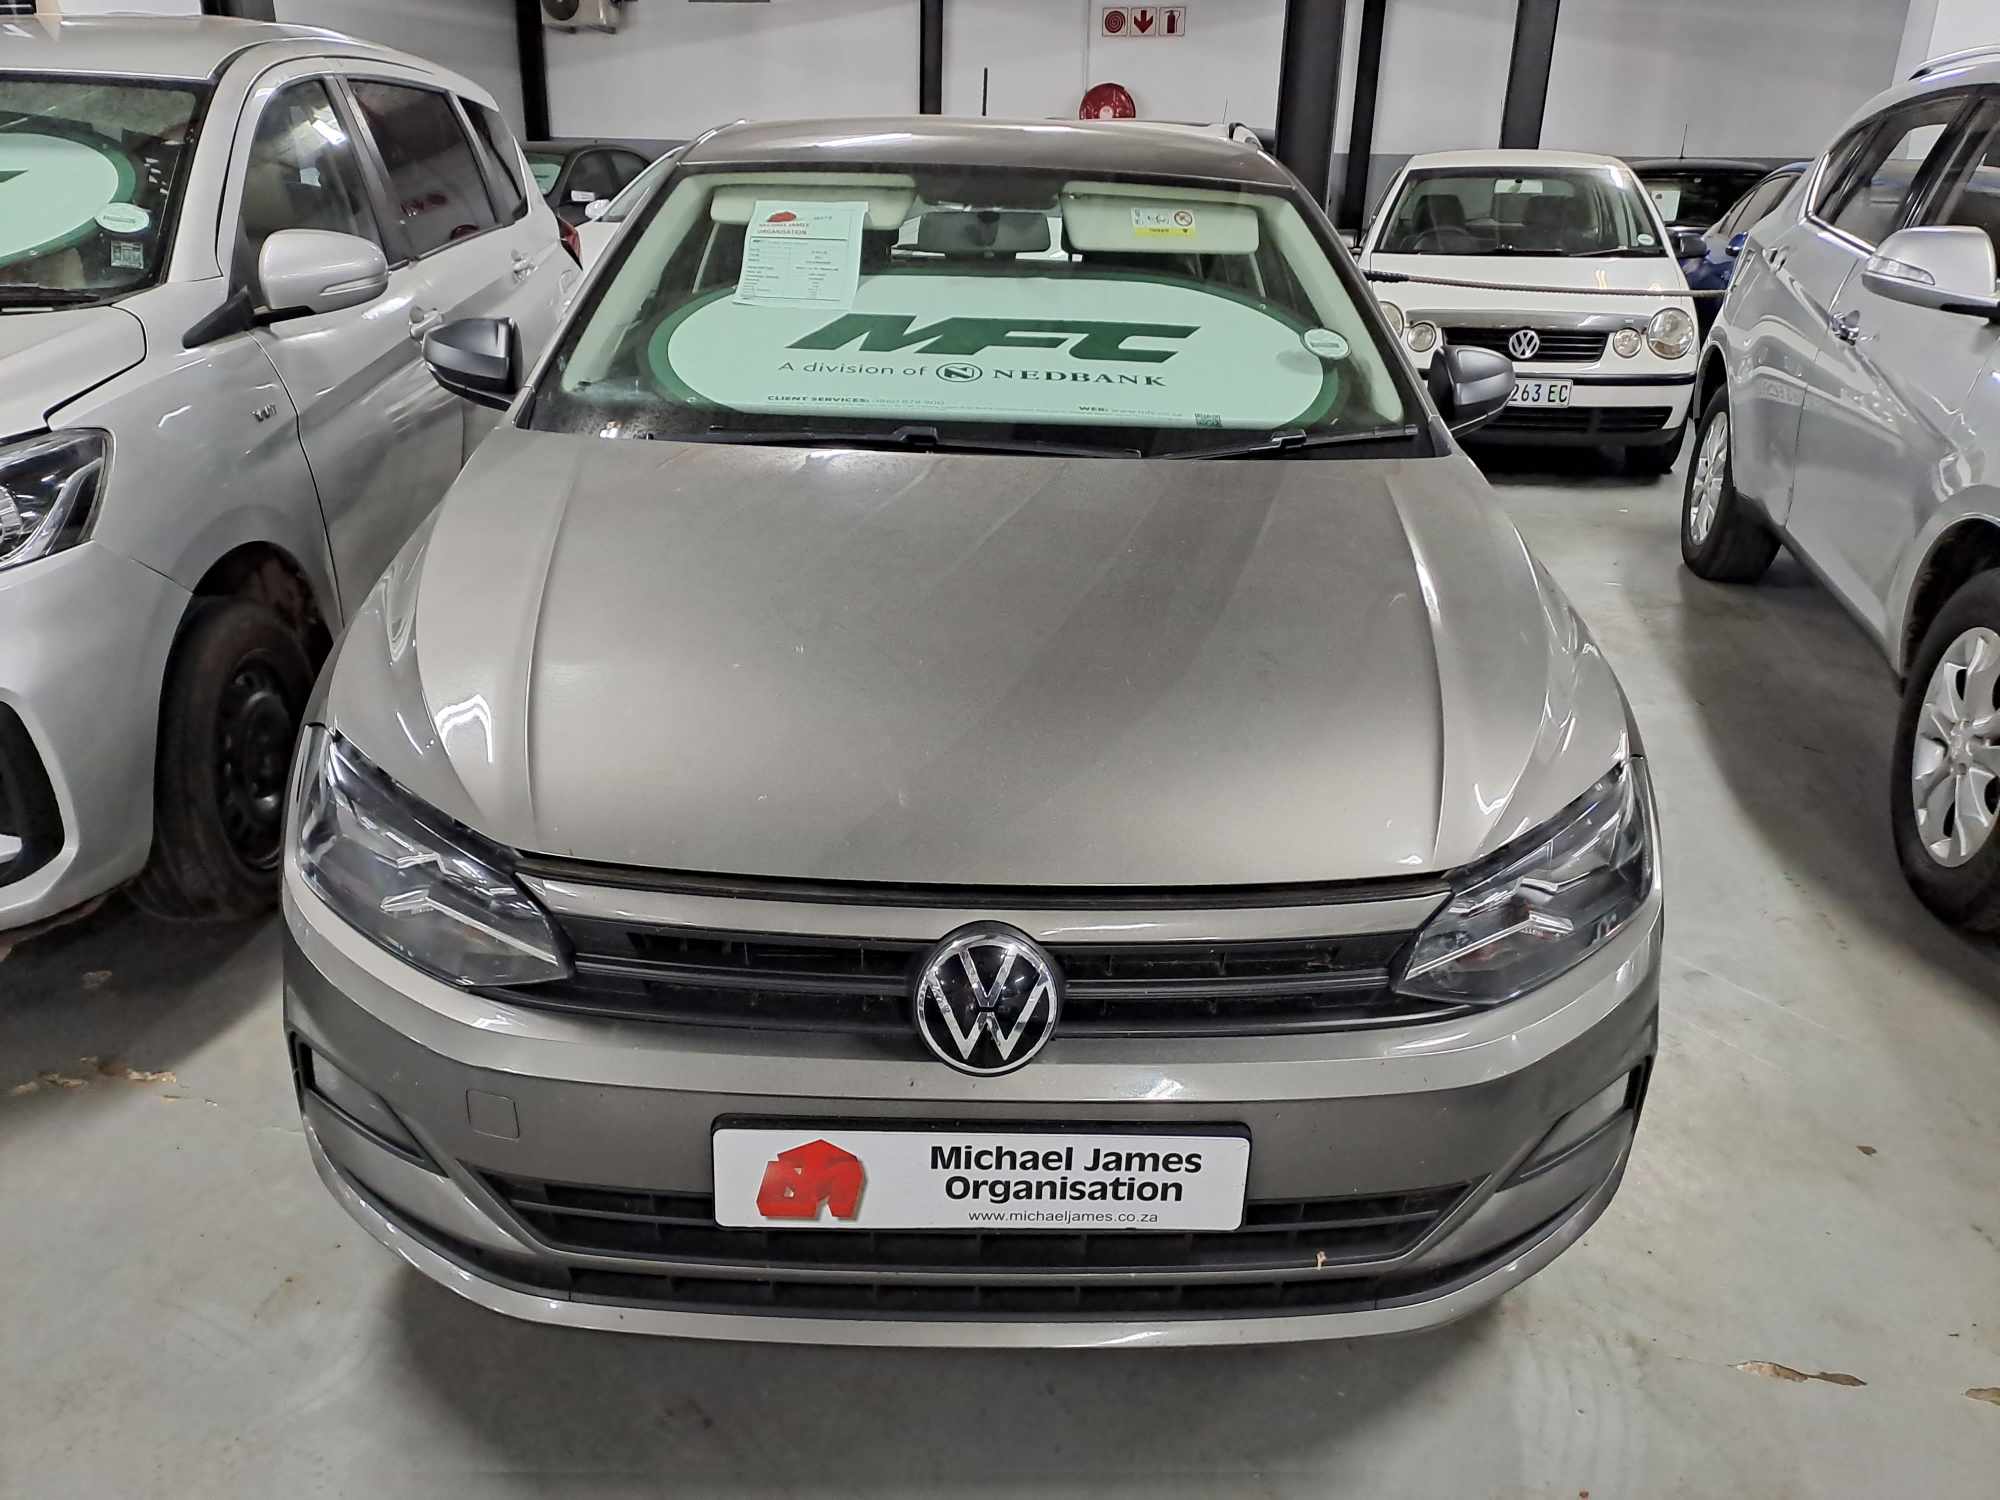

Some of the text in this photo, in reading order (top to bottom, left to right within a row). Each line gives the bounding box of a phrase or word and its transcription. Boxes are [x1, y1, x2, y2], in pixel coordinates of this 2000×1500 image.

[784, 312, 1201, 364] MFC
[1509, 329, 1540, 359] VW
[778, 361, 795, 372] A
[803, 362, 894, 375] division
[902, 366, 928, 376] of
[991, 369, 1167, 387] NEDBANK
[1547, 384, 1568, 403] EC
[919, 937, 1056, 1071] VW
[930, 1145, 1202, 1173] Michael James
[945, 1175, 1183, 1204] Organisation
[968, 1210, 1158, 1225] www.michaeljames.co.za
